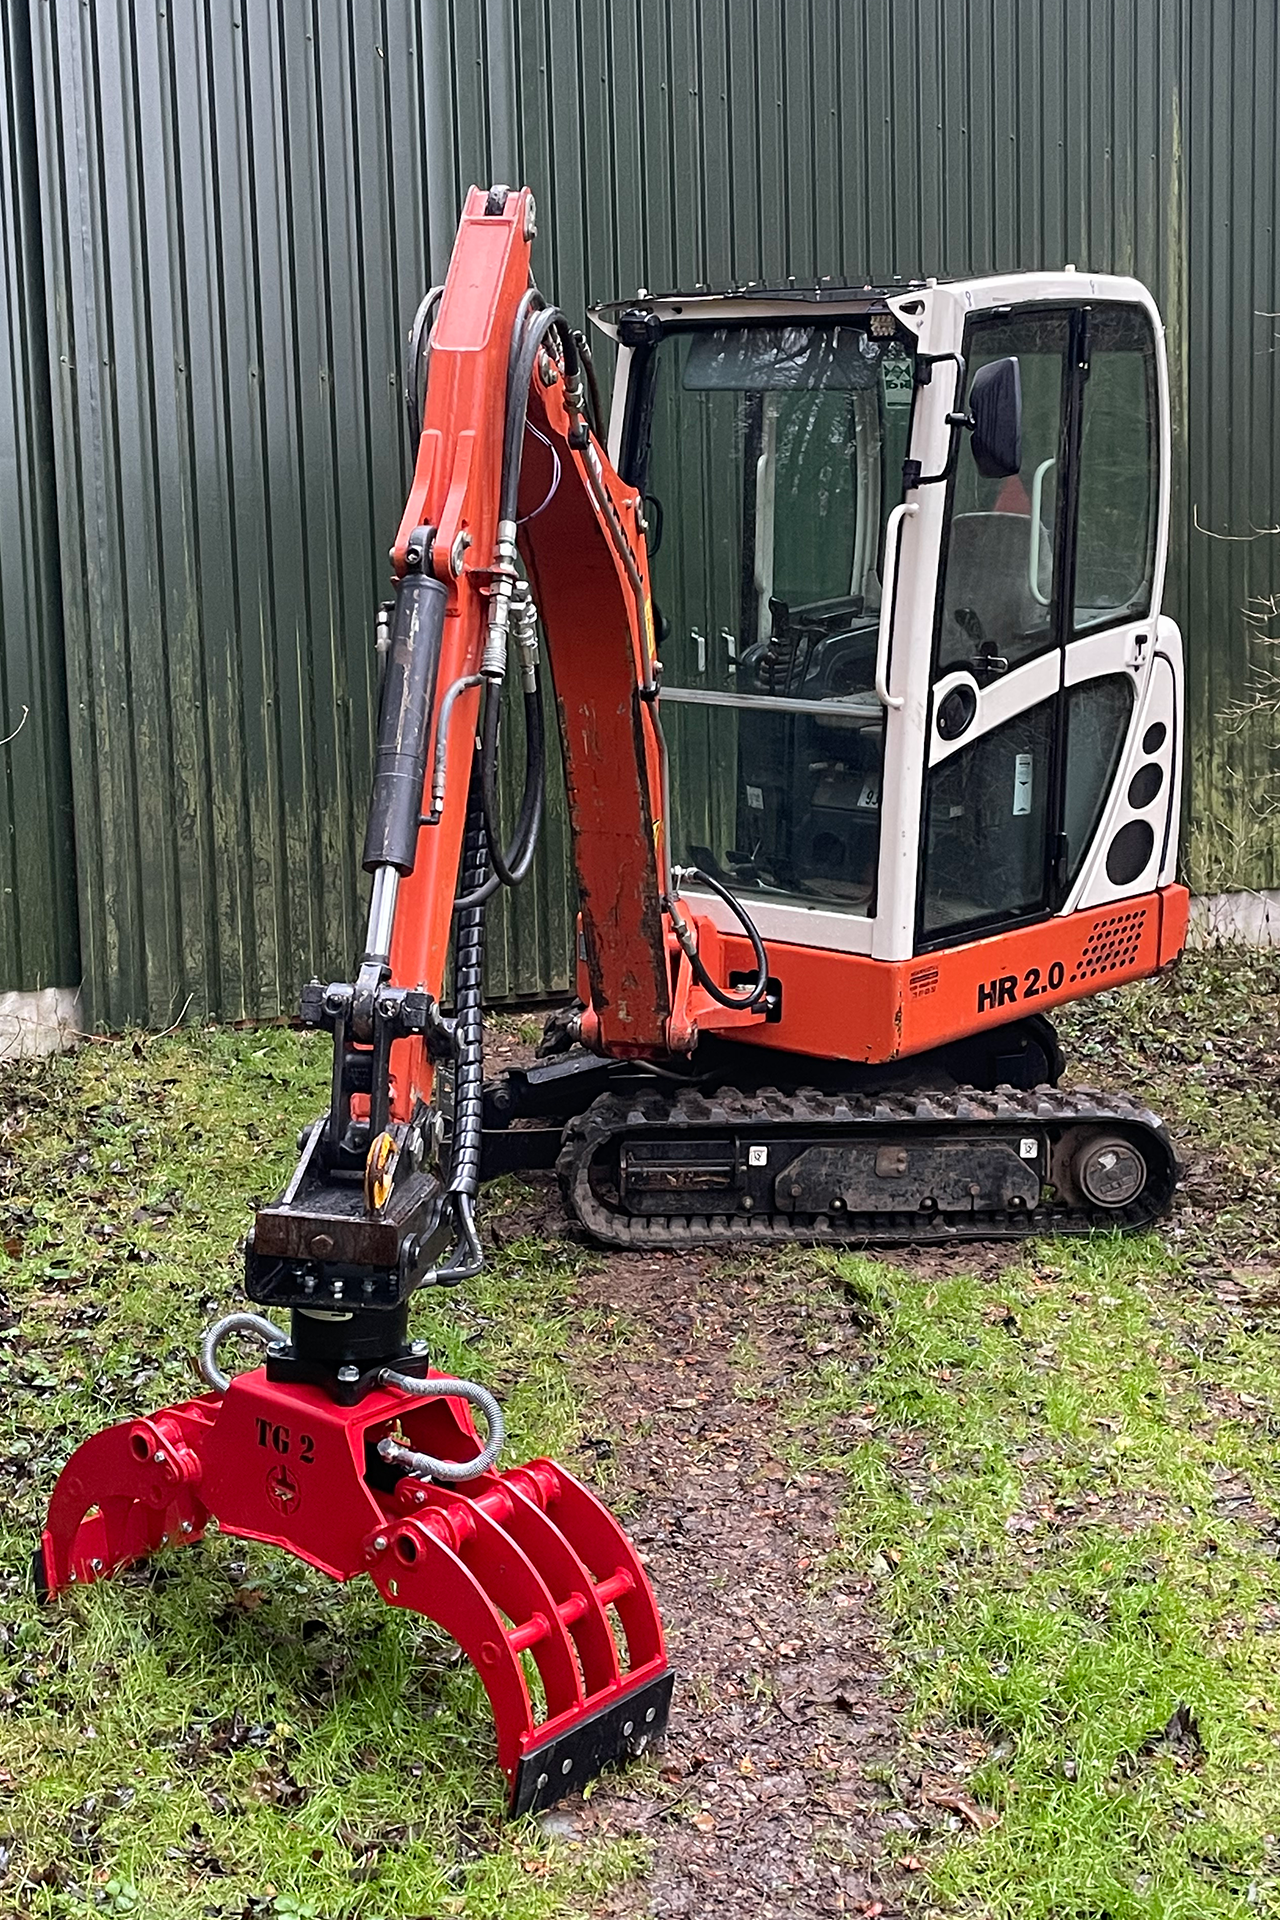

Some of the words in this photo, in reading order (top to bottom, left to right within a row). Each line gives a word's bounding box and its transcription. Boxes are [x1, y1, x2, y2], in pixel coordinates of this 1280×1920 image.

[977, 975, 1018, 1014] HR
[1023, 961, 1065, 999] 2.0
[255, 1417, 290, 1455] TG
[299, 1433, 315, 1465] 2
